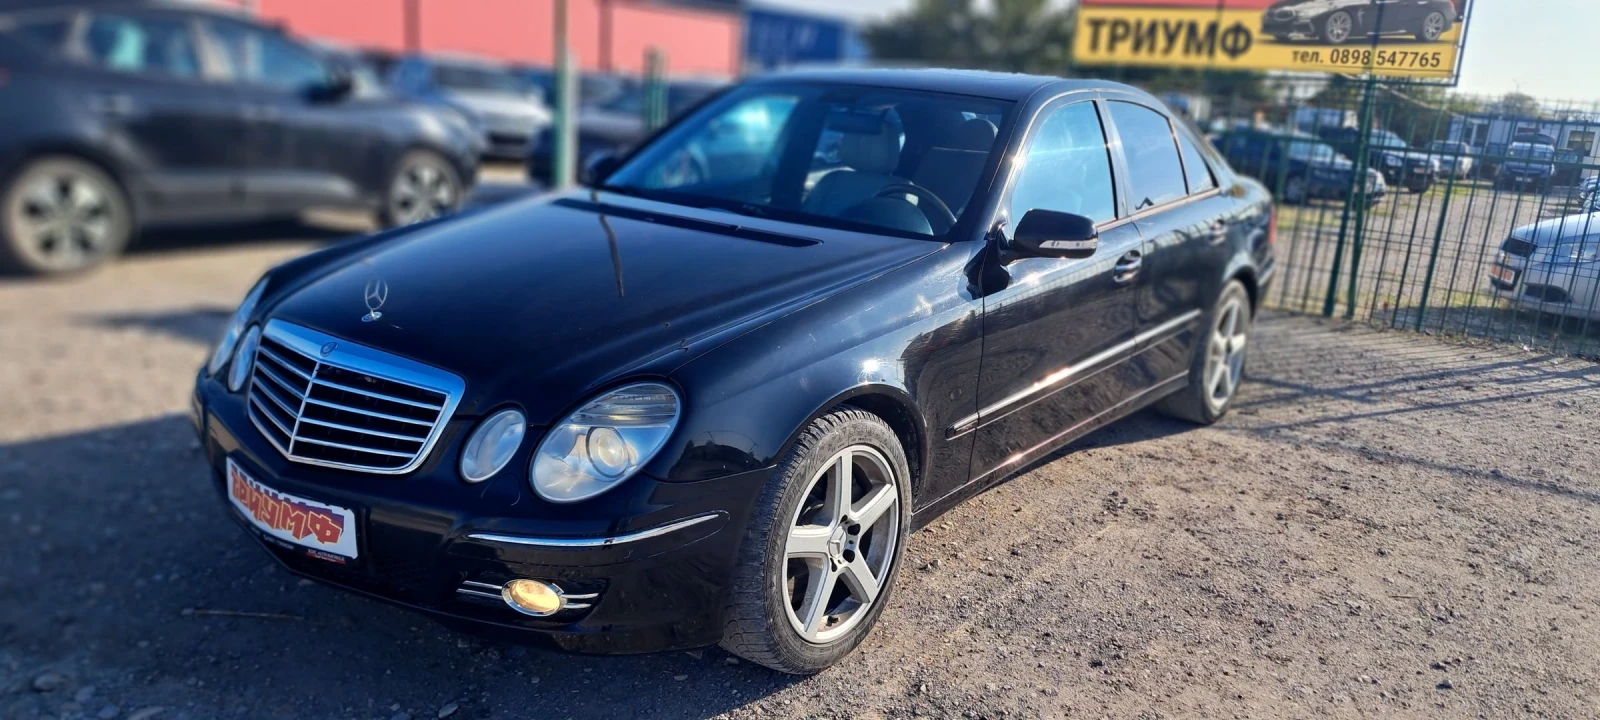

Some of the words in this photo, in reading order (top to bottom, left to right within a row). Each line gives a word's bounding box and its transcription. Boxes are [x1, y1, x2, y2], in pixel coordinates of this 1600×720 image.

[1087, 18, 1253, 60] ТРИУМФ
[1291, 50, 1324, 63] тел.
[1330, 48, 1372, 65] 0898
[1376, 50, 1441, 68] 547765
[231, 466, 343, 545] ТРИУМФ
